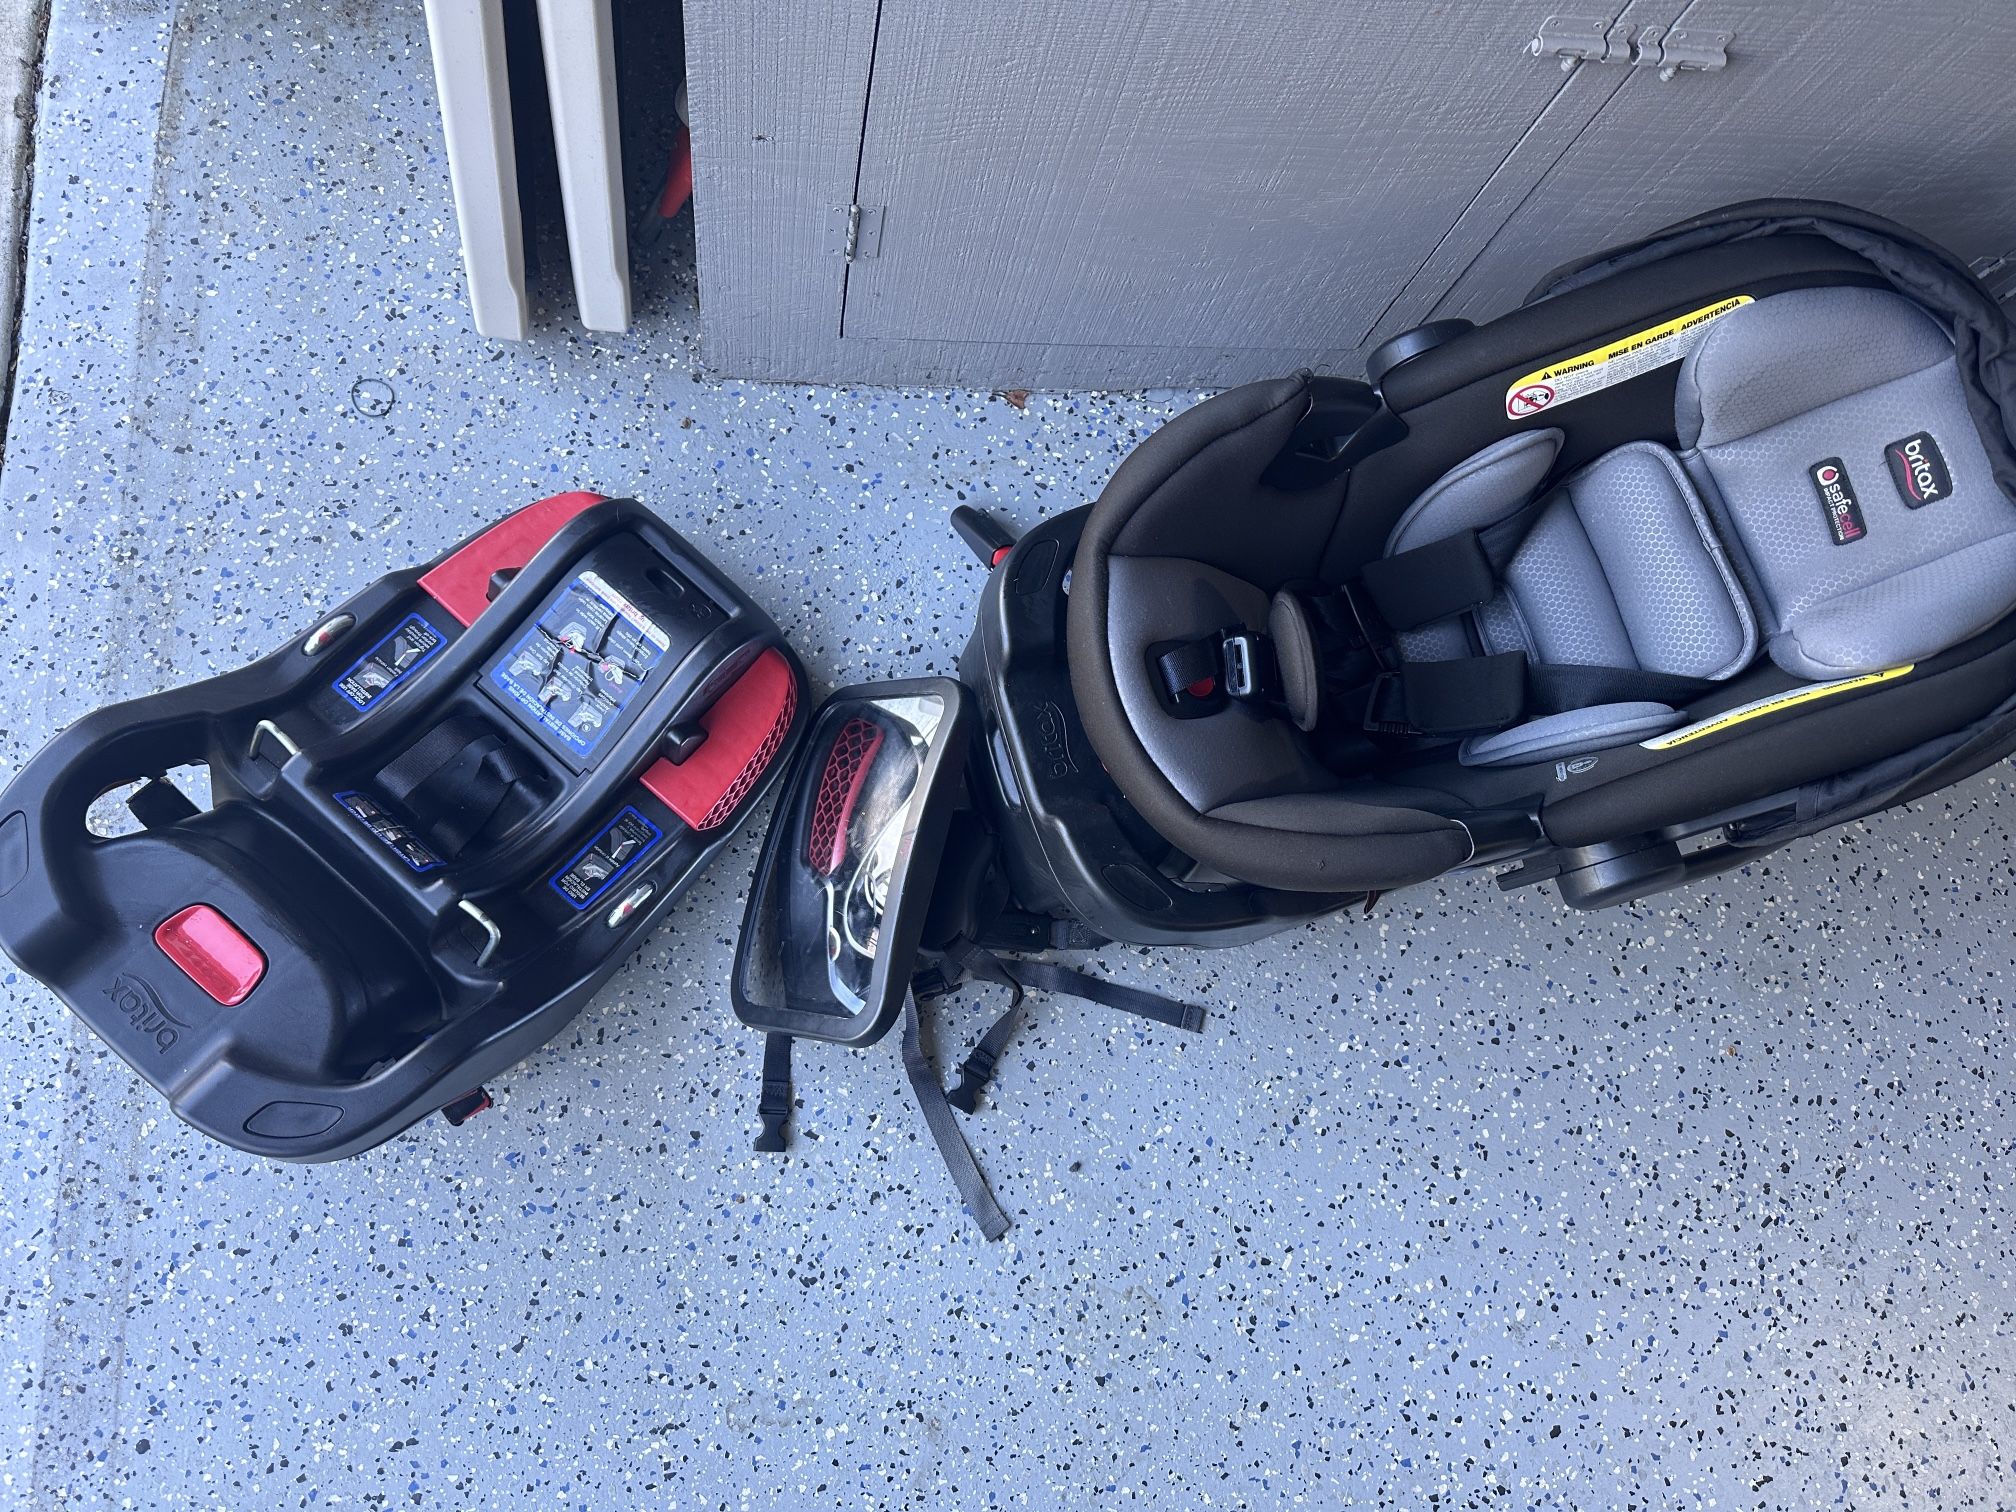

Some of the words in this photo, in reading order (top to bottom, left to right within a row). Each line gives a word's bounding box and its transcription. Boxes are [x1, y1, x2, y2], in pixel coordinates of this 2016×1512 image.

[1680, 299, 1741, 331] ADVERTENCIA
[1608, 346, 1629, 359] MISE
[1631, 341, 1643, 350] EN
[1645, 329, 1675, 346] GARDE
[1553, 360, 1594, 377] WARNING
[1904, 438, 1939, 500] britax
[1829, 483, 1863, 538] safecell
[1830, 507, 1844, 540] PROTECTION
[345, 676, 372, 699] INSTALLATION
[346, 682, 357, 692] BASE
[500, 671, 514, 684] BASE
[511, 682, 520, 690] LA
[345, 687, 366, 706] LOCK-OFF
[355, 690, 365, 699] FOR
[506, 685, 528, 705] OPTIONS
[518, 687, 527, 696] DE
[526, 702, 559, 731] INSTALLATION
[553, 717, 562, 726] DE
[557, 728, 571, 741] BASE
[560, 723, 586, 746] OPCIONES
[1033, 701, 1068, 779] britax
[102, 976, 180, 1055] britax
